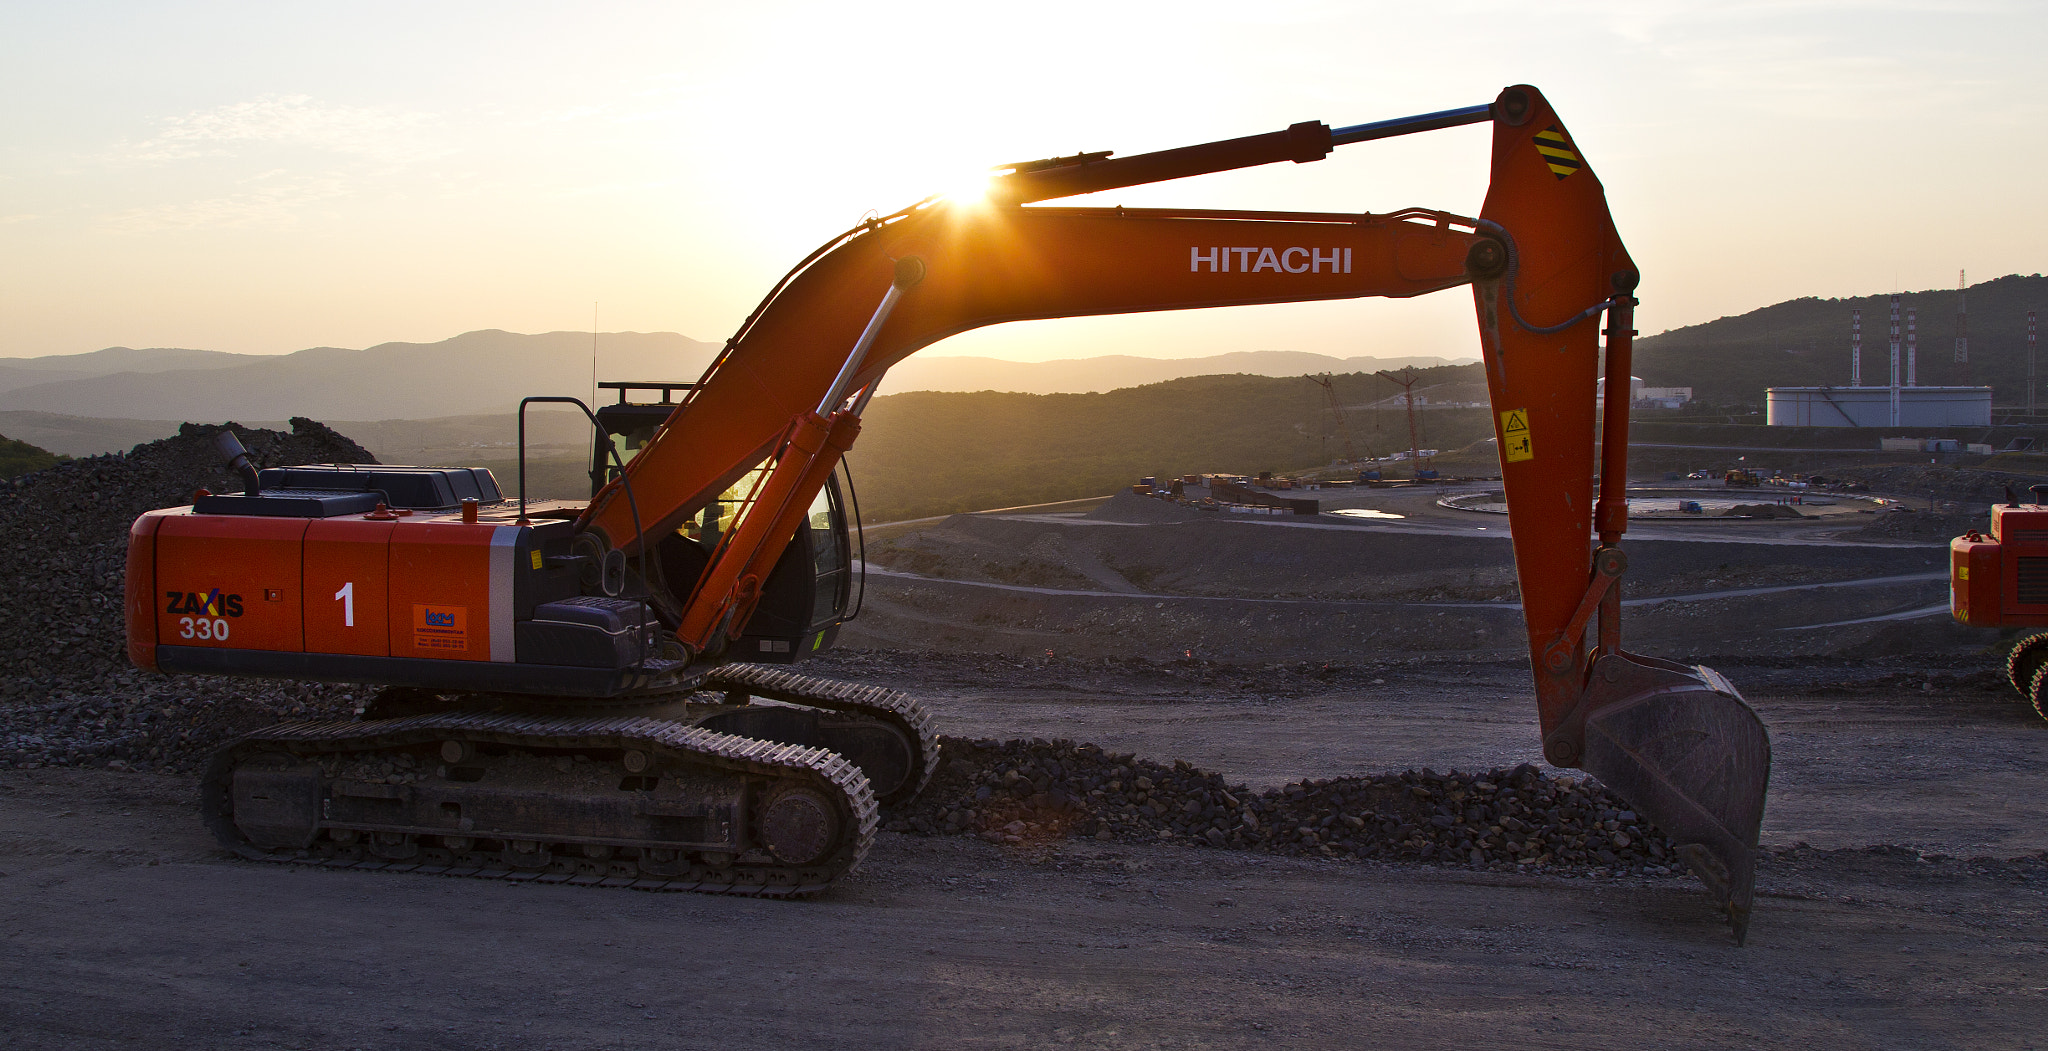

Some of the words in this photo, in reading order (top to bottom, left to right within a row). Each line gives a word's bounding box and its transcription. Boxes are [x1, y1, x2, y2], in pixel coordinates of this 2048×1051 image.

[1191, 246, 1352, 274] HITACHI
[166, 588, 244, 617] ZAXIS
[335, 582, 354, 627] 1
[179, 617, 229, 641] 330
